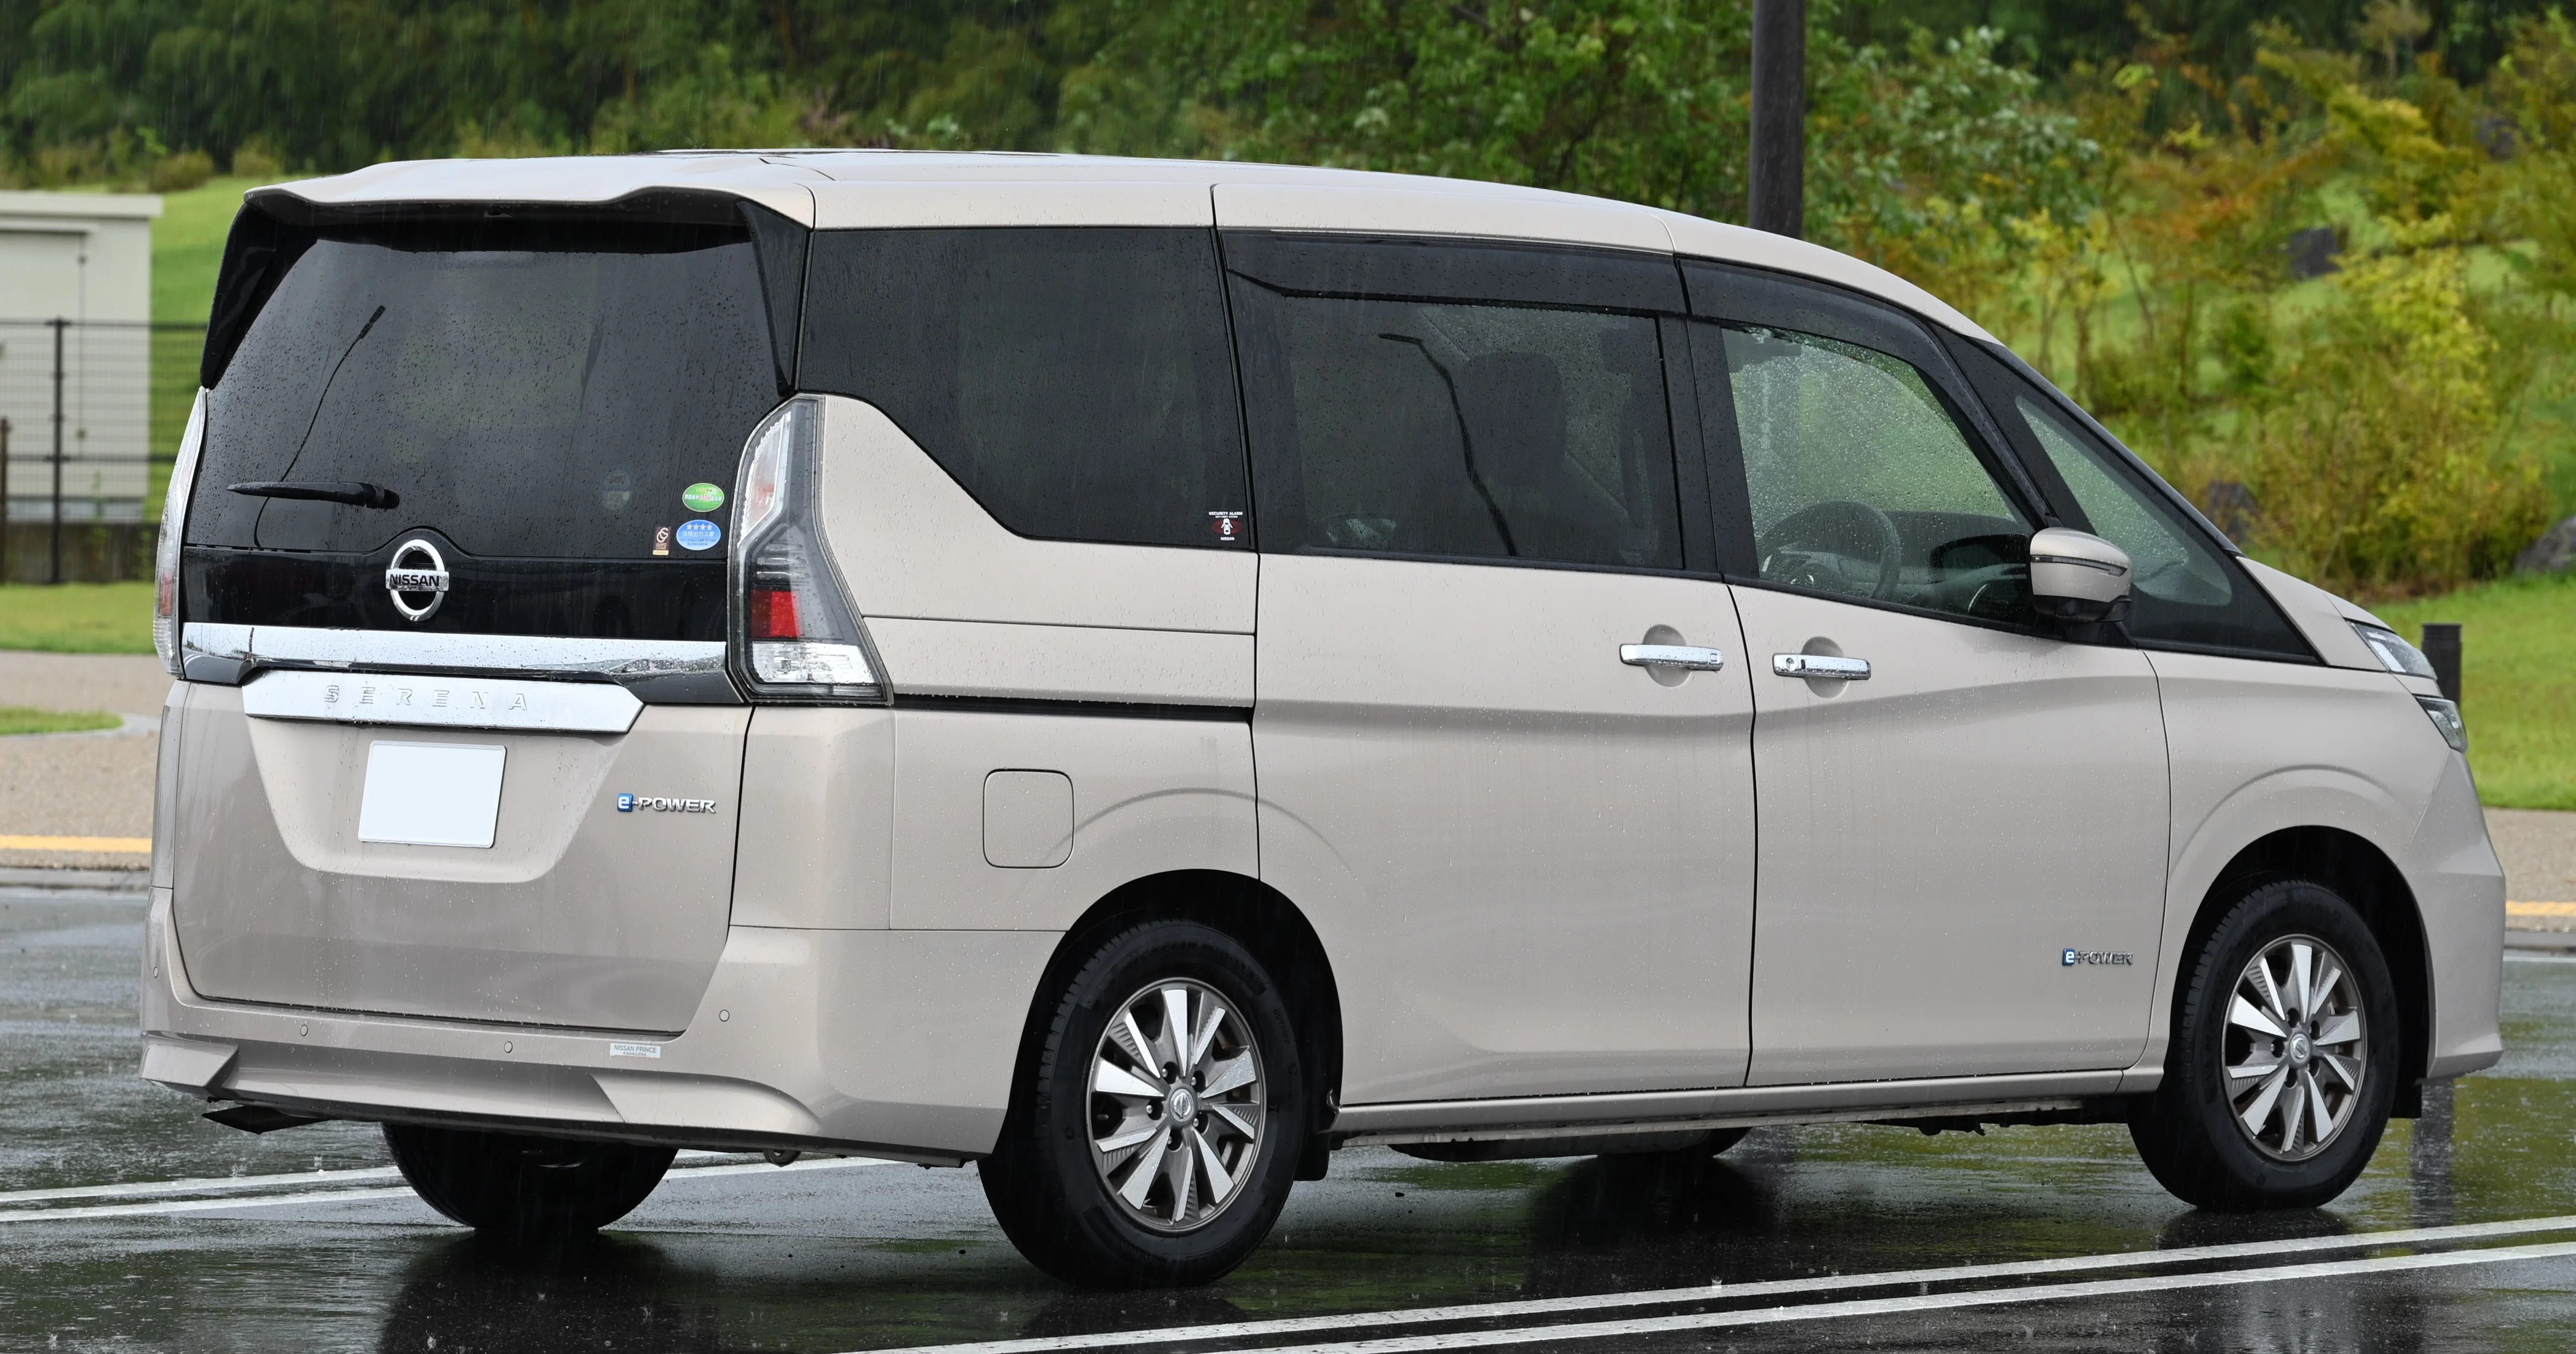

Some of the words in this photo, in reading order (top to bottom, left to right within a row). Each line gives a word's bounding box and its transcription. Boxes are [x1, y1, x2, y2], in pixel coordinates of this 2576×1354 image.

[389, 574, 440, 587] NISSAN
[324, 685, 528, 711] SERENA
[617, 793, 716, 814] e-POWER
[2062, 948, 2133, 966] e-POWER
